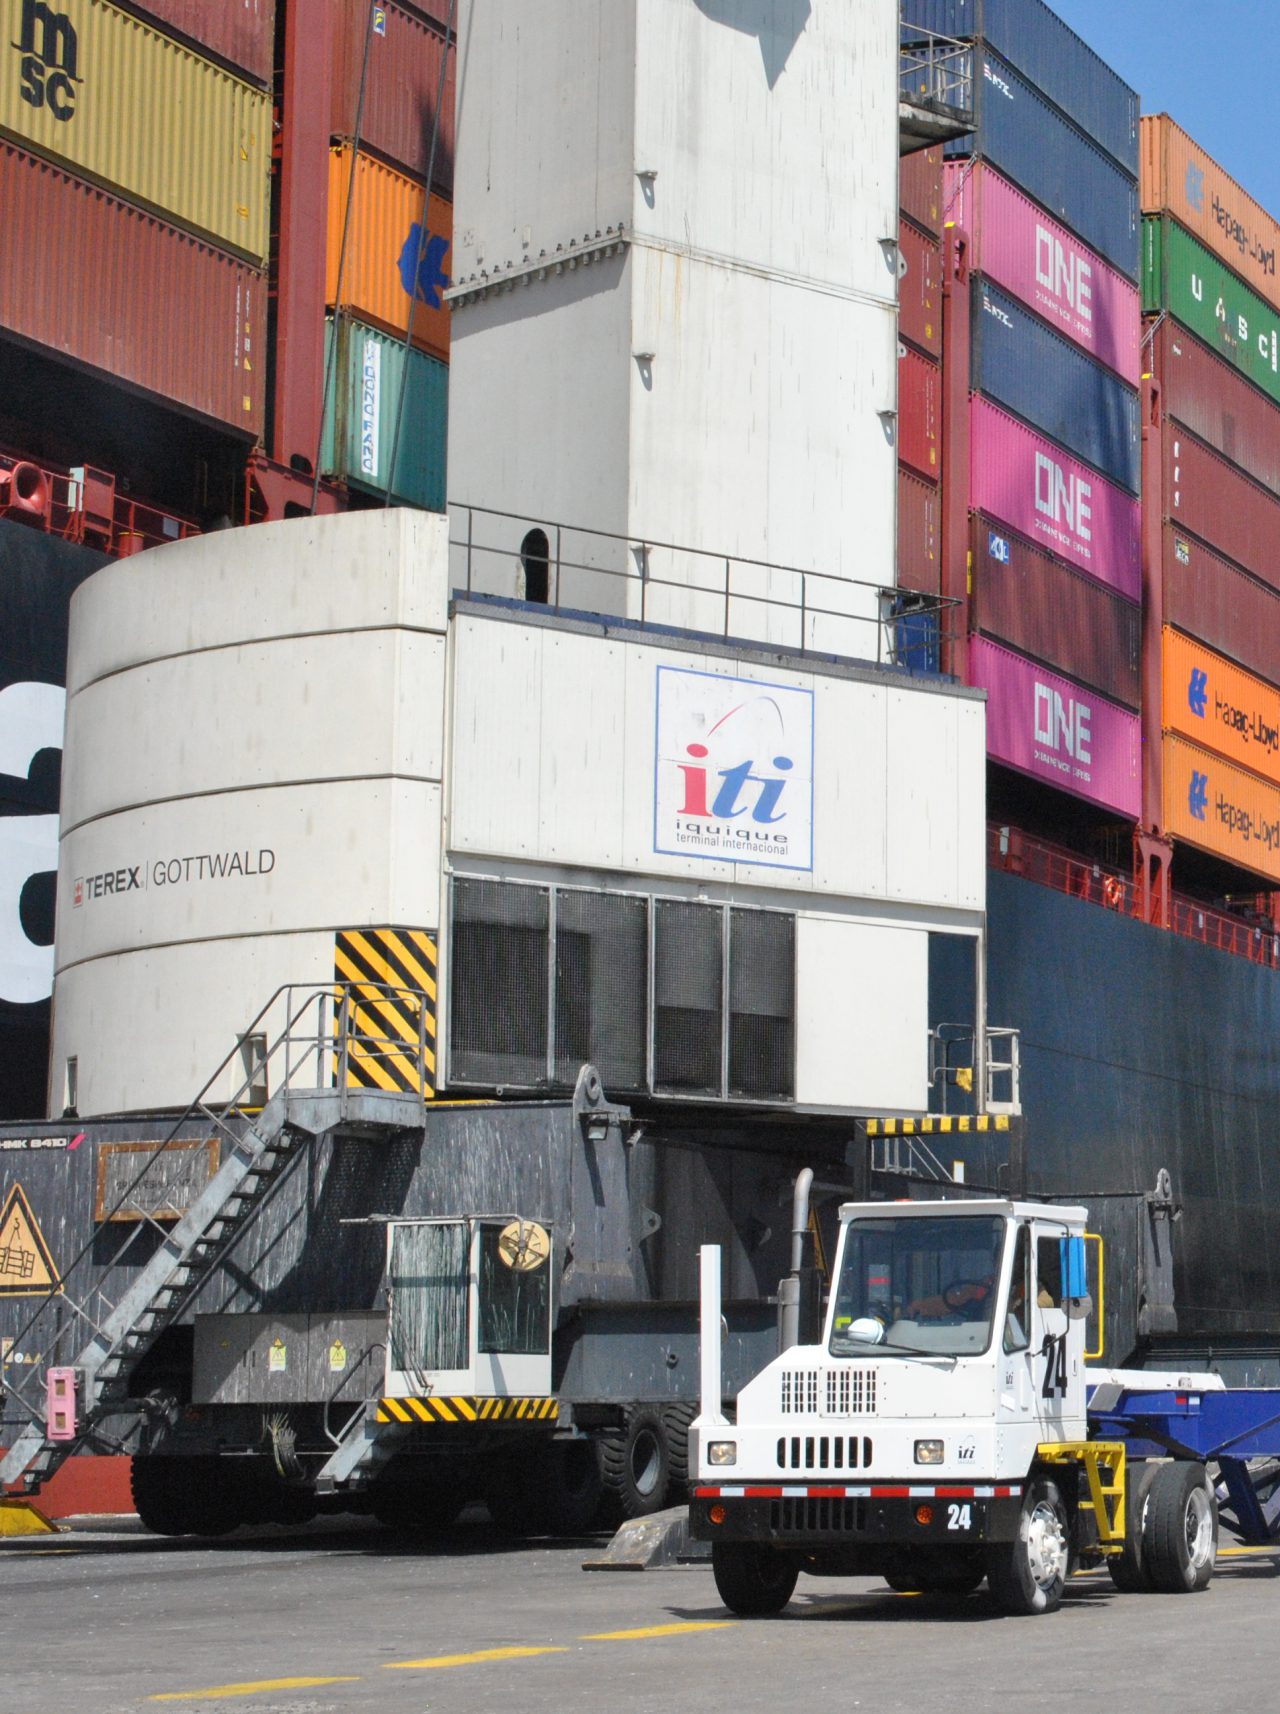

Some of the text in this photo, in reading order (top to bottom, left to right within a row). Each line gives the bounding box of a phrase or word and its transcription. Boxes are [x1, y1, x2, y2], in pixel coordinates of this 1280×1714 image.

[1036, 224, 1092, 322] ONE
[1035, 451, 1092, 542] ONE
[1034, 681, 1092, 765] ONE
[676, 743, 794, 824] iti
[676, 819, 788, 843] iquique
[676, 832, 788, 855] terminal internacional
[86, 849, 276, 900] TEREX GOTTWALD
[31, 1138, 67, 1148] 8410
[1042, 1333, 1067, 1398] 24
[958, 1445, 975, 1459] iti
[947, 1504, 972, 1530] 24
